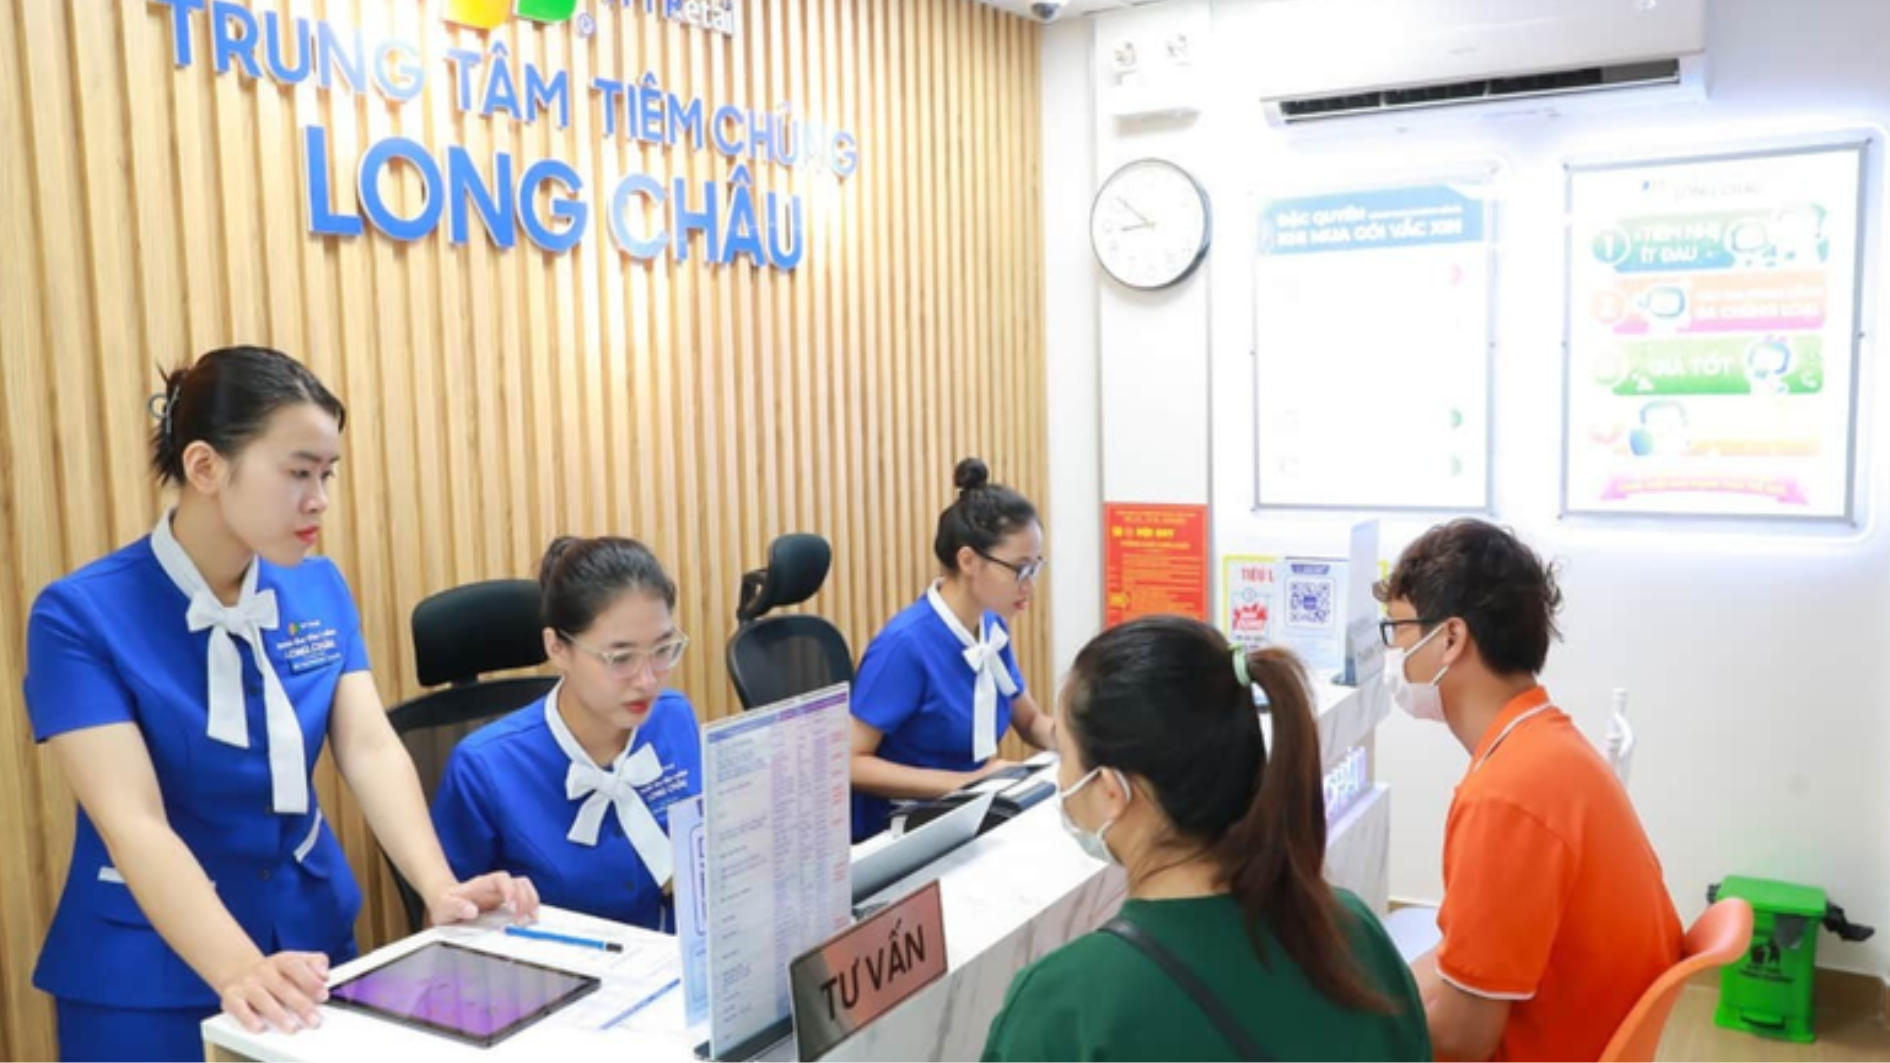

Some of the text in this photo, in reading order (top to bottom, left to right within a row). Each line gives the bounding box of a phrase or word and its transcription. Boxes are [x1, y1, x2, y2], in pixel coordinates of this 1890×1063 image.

[154, 0, 425, 100] TRUNG
[447, 43, 569, 128] TÂM
[594, 74, 703, 150] TIÊM
[304, 125, 802, 270] LONG CHÂU
[819, 919, 927, 1021] TƯ VẤN
